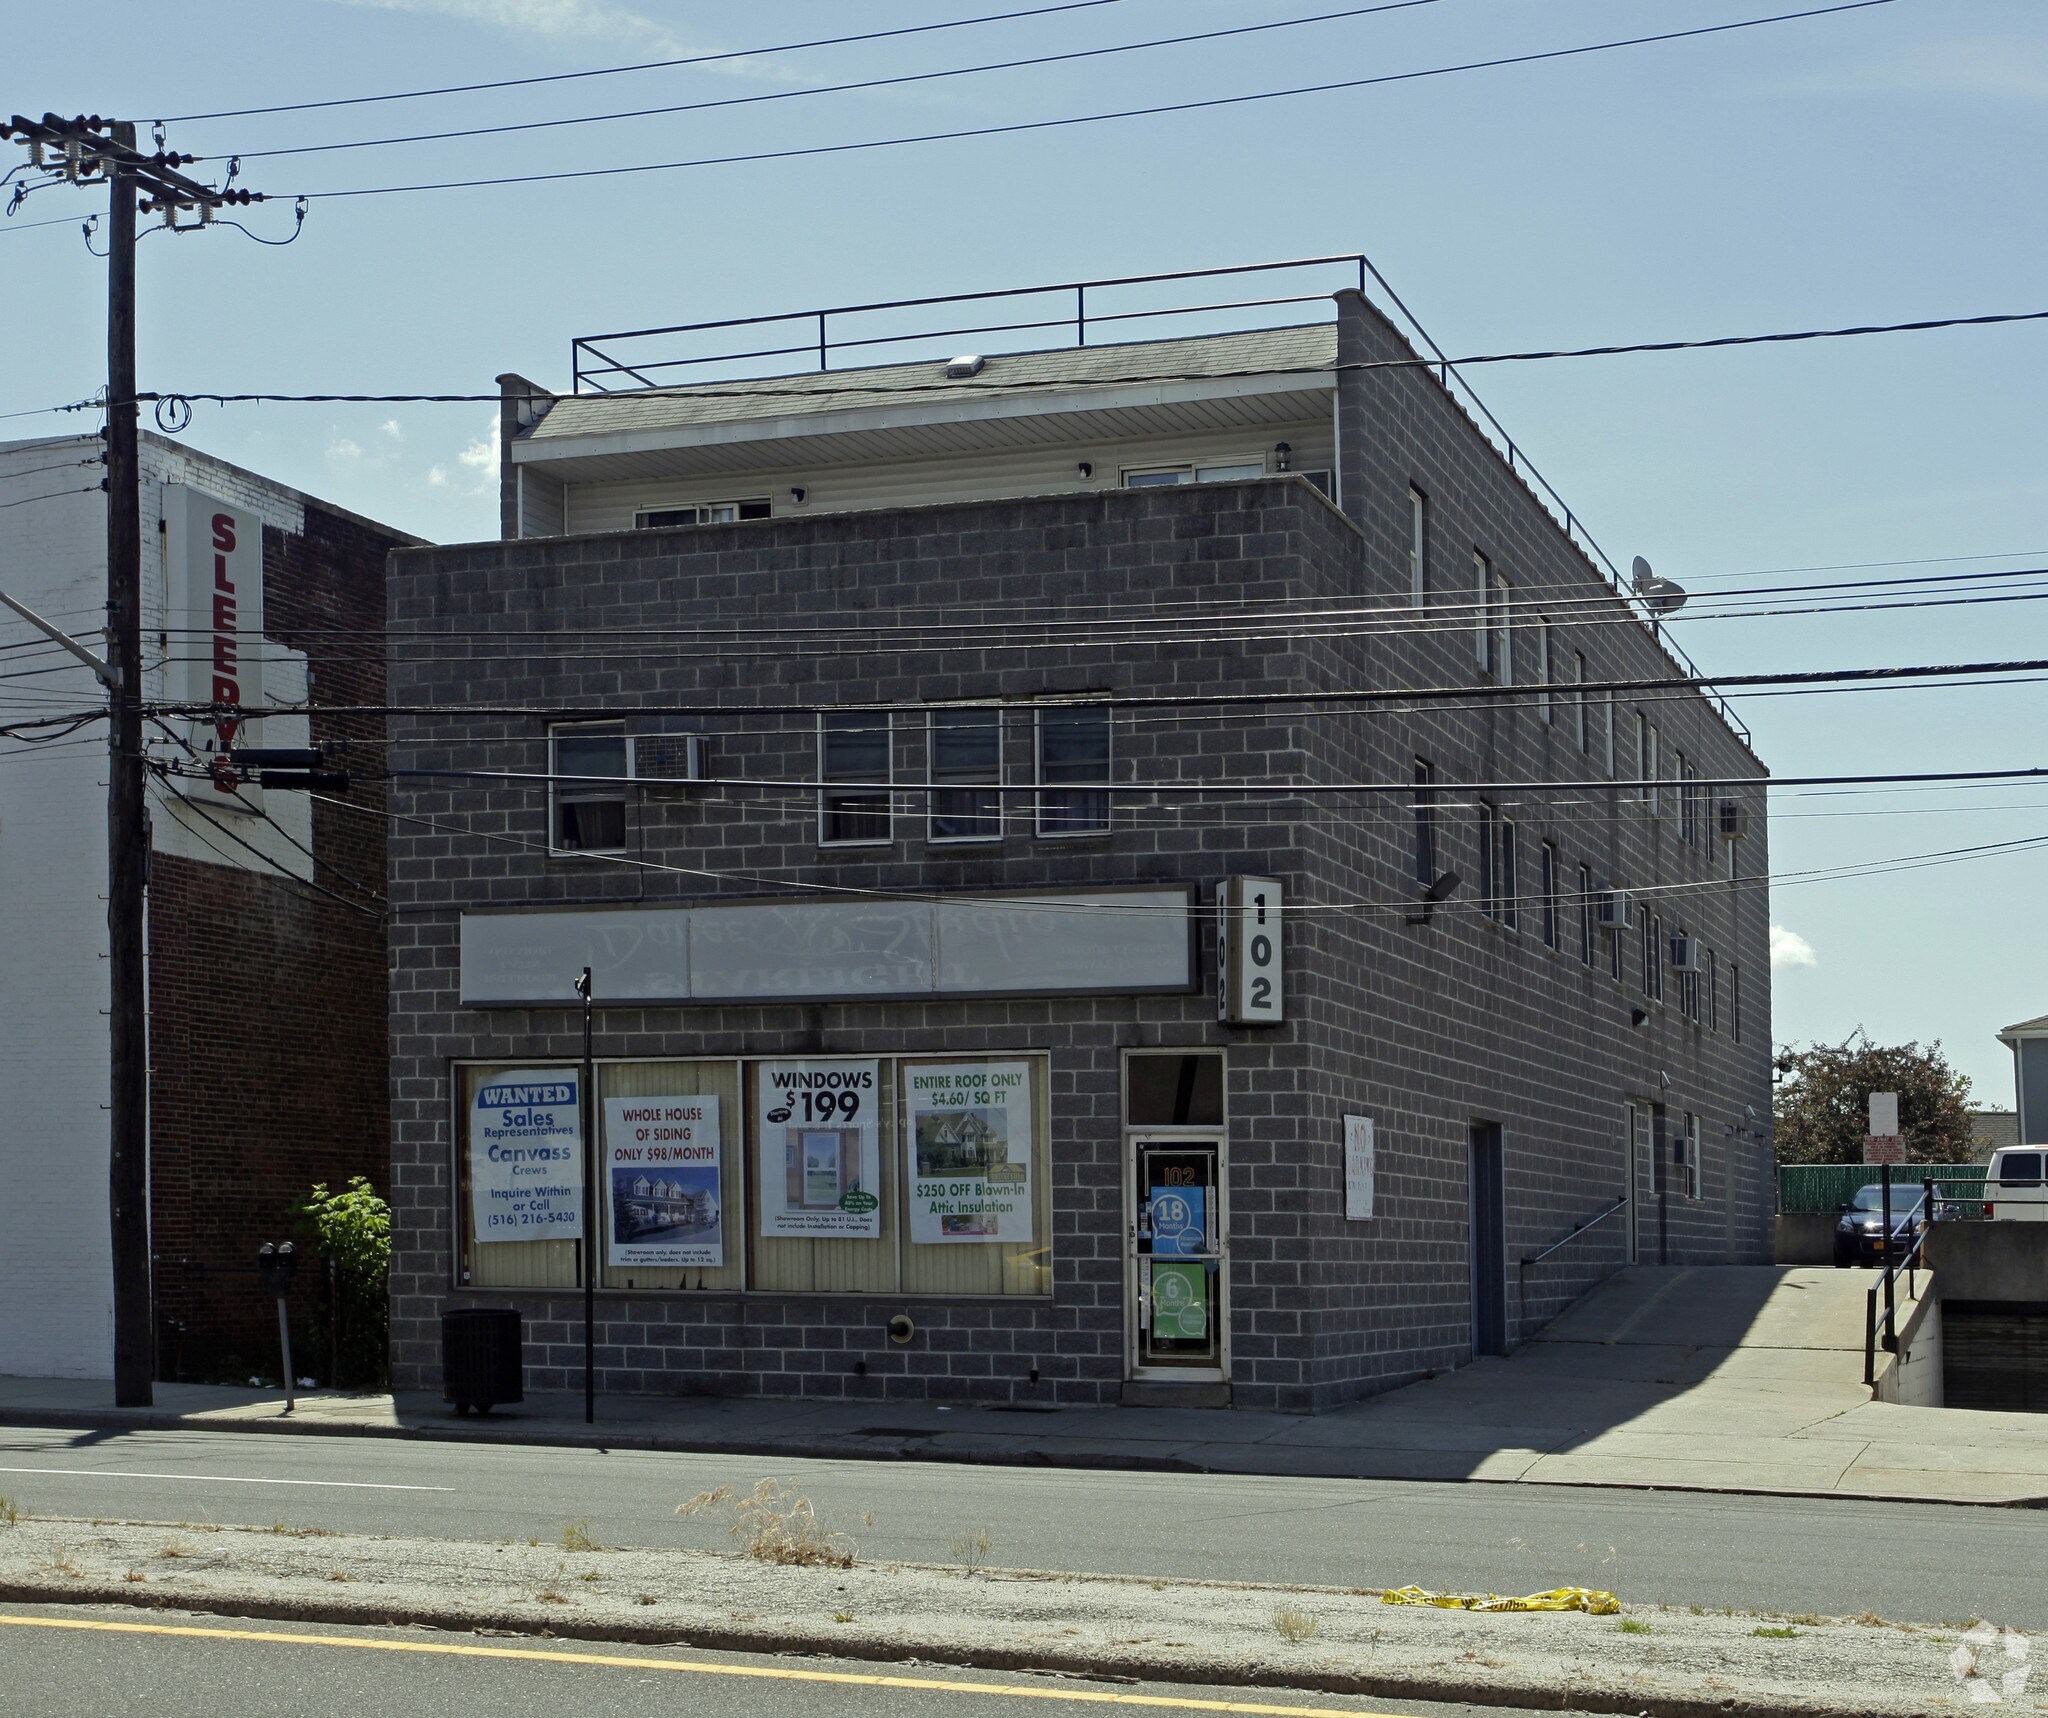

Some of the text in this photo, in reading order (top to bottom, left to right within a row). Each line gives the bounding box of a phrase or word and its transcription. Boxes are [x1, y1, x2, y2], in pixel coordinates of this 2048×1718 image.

[1250, 893, 1272, 1010] 102
[771, 1071, 873, 1090] WINDOWS
[913, 1073, 1023, 1089] ENTIRE ROOF ONLY
[483, 1085, 571, 1105] WANTED
[931, 1090, 1007, 1106] $4.60/ SQ FT
[785, 1090, 860, 1122] $199
[502, 1109, 554, 1127] Sales
[622, 1108, 702, 1122] WHOLE HOUSE
[484, 1124, 574, 1139] Representatives
[635, 1128, 692, 1141] OF SIDING
[1354, 1124, 1367, 1153] NO
[487, 1144, 571, 1163] Canvass
[614, 1147, 714, 1161] ONLY $98/MONTH
[512, 1165, 548, 1176] Crews
[1164, 1167, 1195, 1186] 102
[491, 1187, 571, 1201] Inquire Within
[916, 1182, 1025, 1198] $250 OFF Blown-In
[512, 1200, 550, 1211] or Call
[928, 1200, 1013, 1214] Attic Insulation
[1158, 1200, 1184, 1220] 18
[487, 1212, 575, 1227] (516) 216-5430
[1158, 1222, 1184, 1230] Months
[1165, 1277, 1179, 1299] 6
[1161, 1299, 1185, 1307] Months
